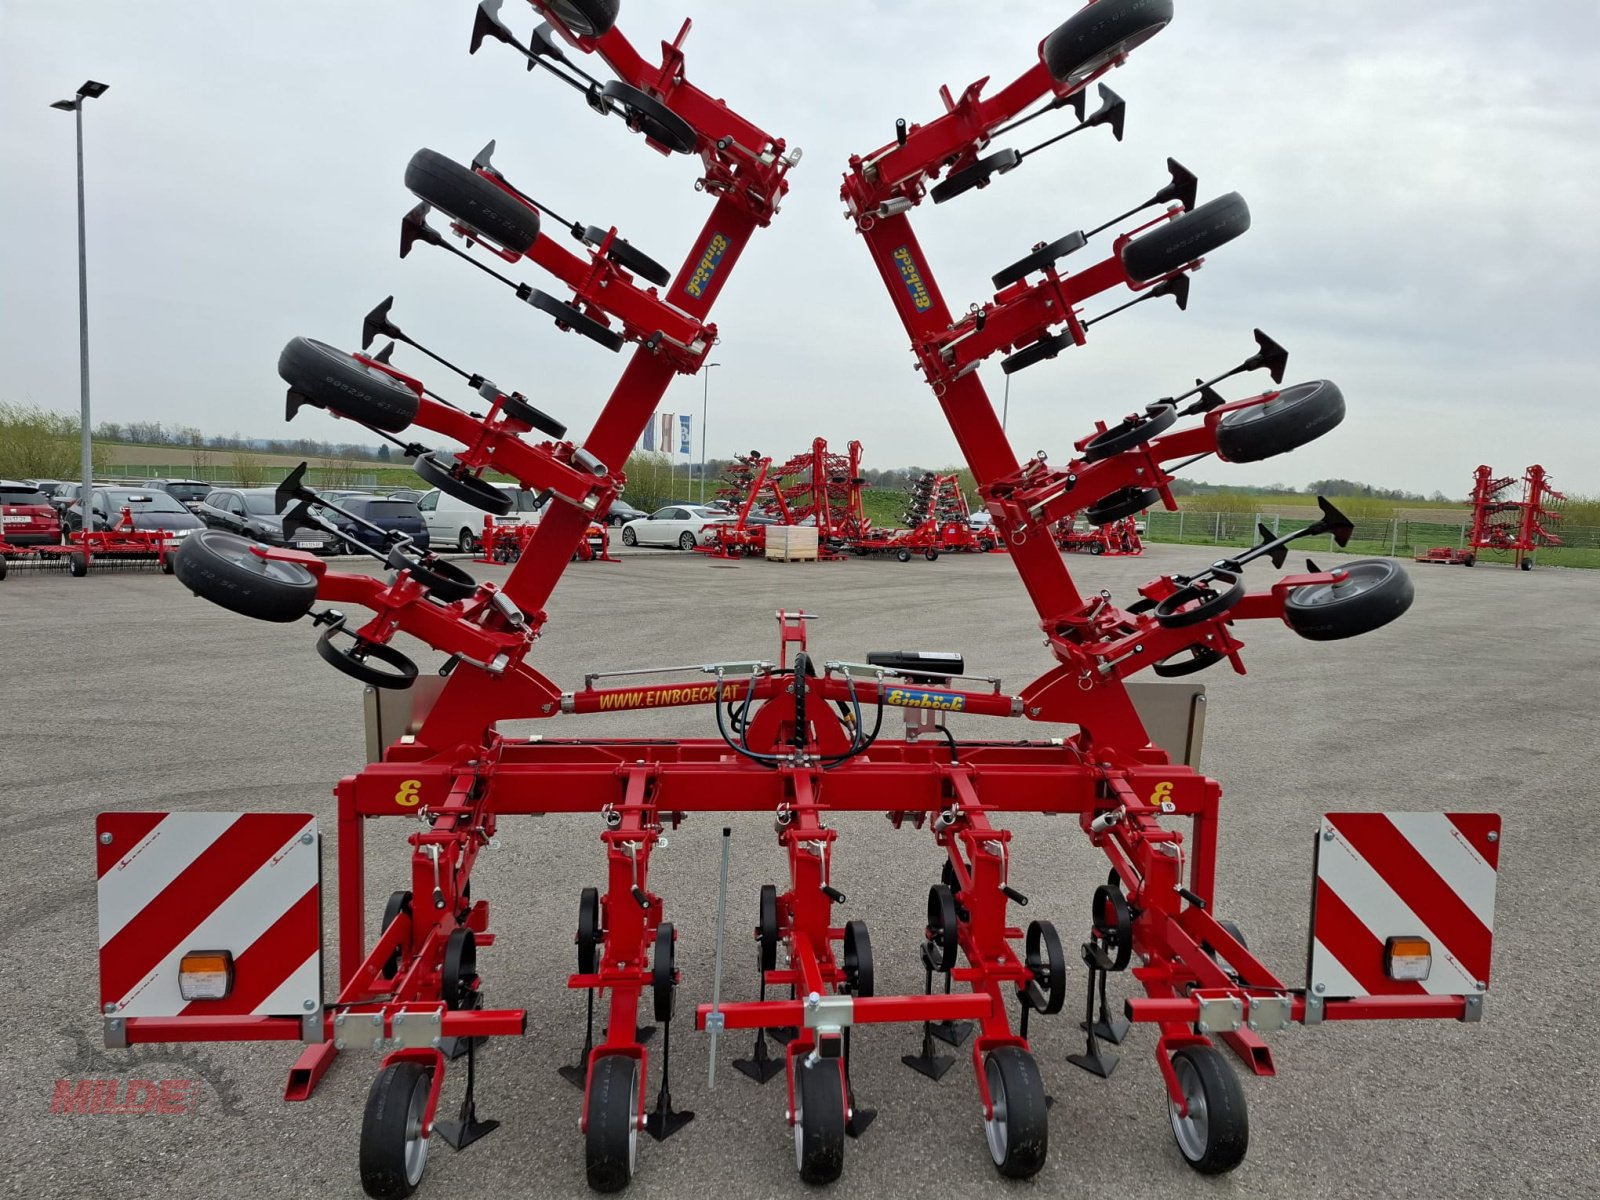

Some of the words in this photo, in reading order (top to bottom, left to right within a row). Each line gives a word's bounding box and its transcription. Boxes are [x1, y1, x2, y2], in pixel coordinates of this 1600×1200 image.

[687, 234, 727, 297] Einböck
[893, 247, 930, 308] Einböck
[600, 684, 740, 710] WWW.EINBOECKAT
[888, 689, 963, 711] Einböck
